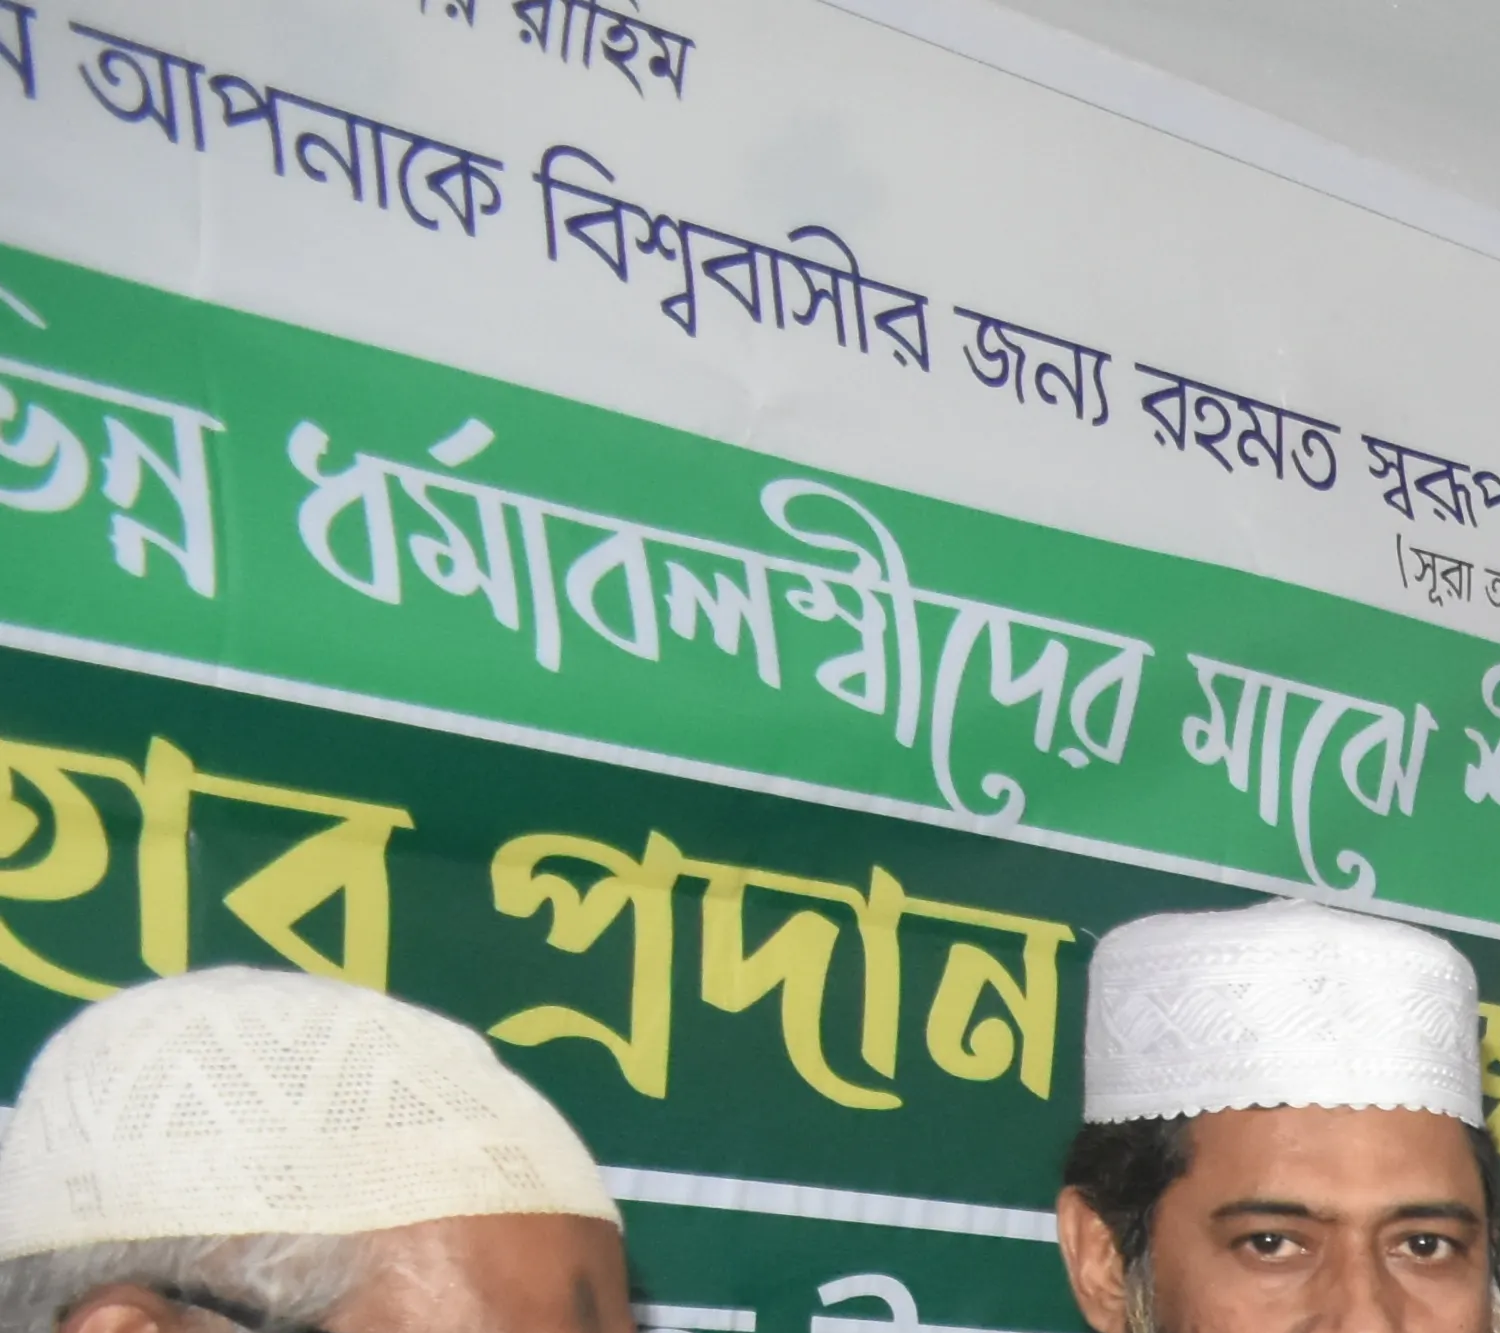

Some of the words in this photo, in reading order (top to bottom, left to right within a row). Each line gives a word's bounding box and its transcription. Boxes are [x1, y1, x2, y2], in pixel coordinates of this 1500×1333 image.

[69, 21, 504, 236] আপনাকে
[533, 144, 930, 371] বিশ্ববাসীর
[953, 306, 1111, 427] জন্য
[1136, 362, 1340, 491] রহমত
[287, 418, 1155, 826] ধর্মাবলম্বীদের
[1183, 655, 1439, 899] মাঝে
[1396, 533, 1474, 606] (সূরা
[488, 830, 1073, 1110] প্রদান
